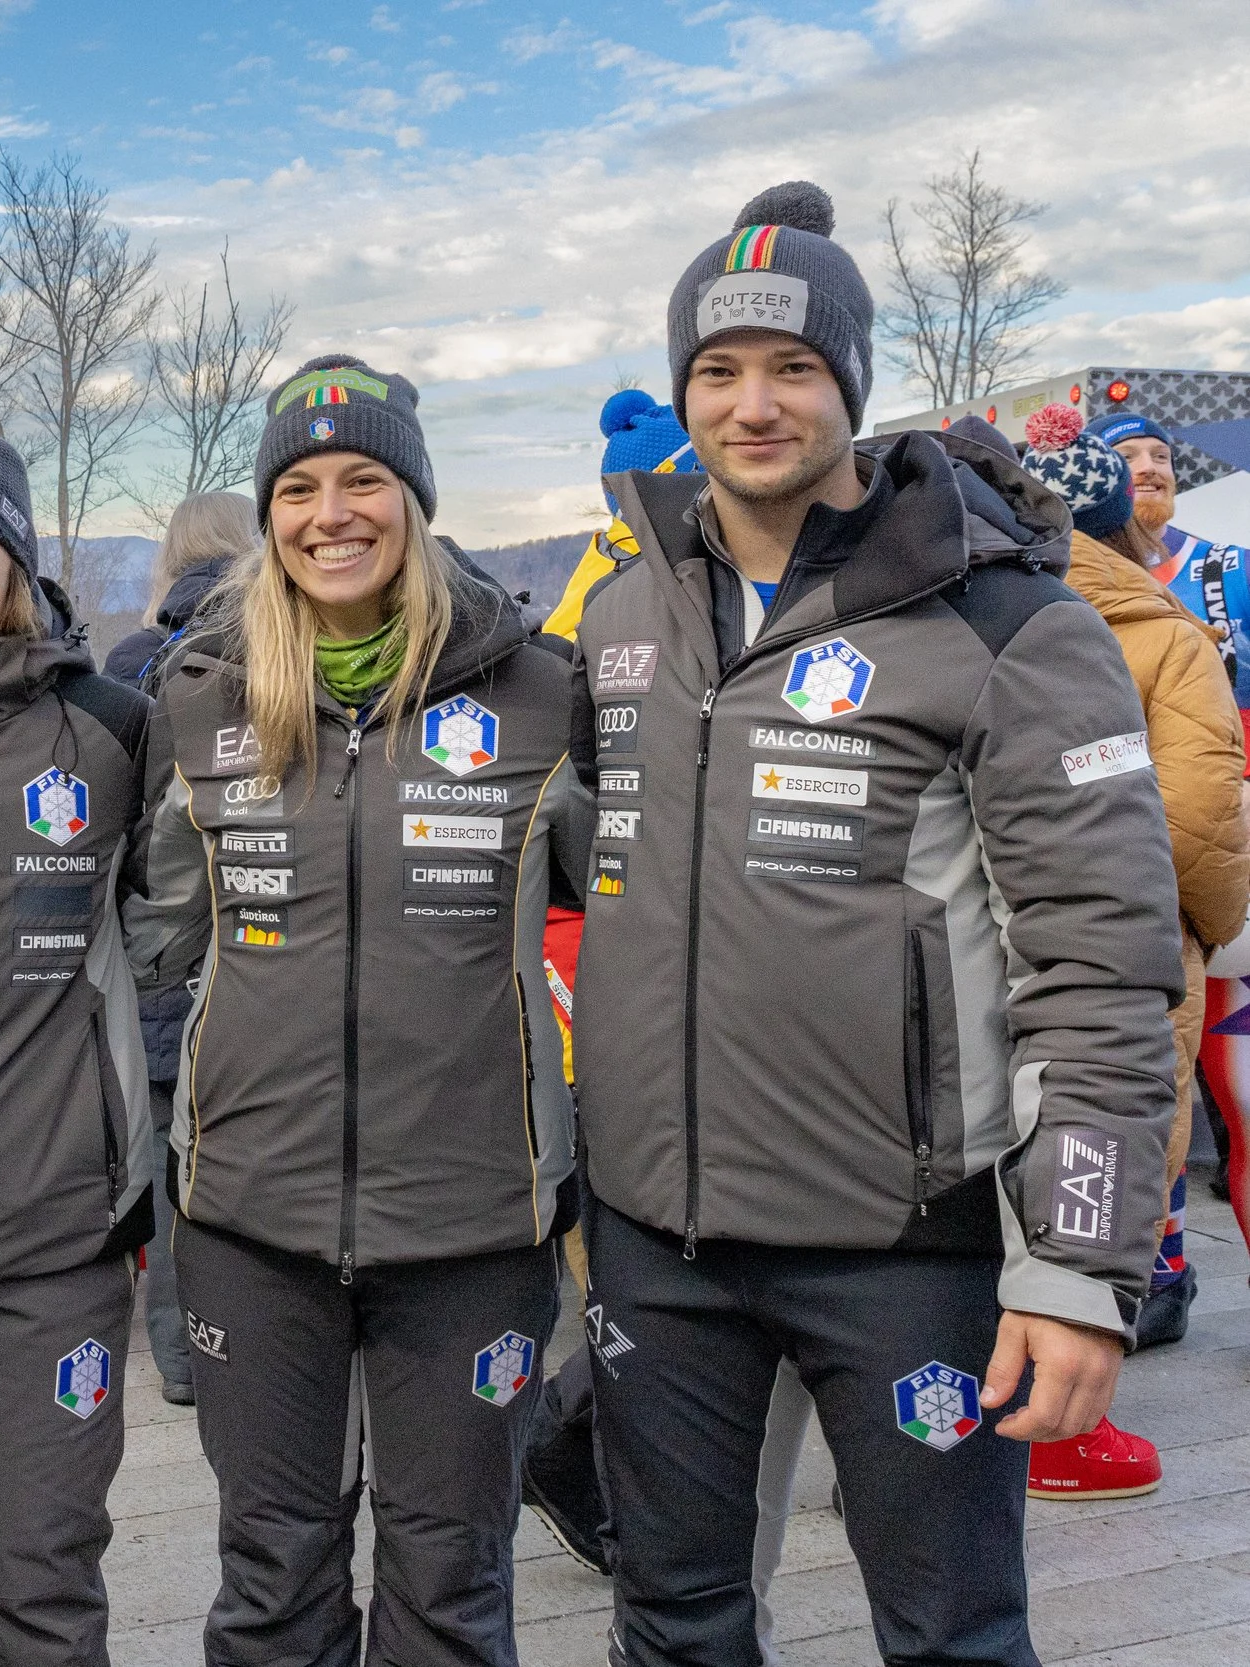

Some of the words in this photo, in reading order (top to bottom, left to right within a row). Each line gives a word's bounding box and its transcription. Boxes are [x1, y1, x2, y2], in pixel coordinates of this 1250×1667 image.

[711, 292, 792, 310] PUTZER
[1204, 581, 1236, 660] uvex
[598, 645, 655, 679] EA7
[811, 645, 860, 669] FISI
[439, 702, 485, 721] FISI
[217, 723, 262, 758] EA
[754, 728, 871, 756] FALCONERI
[1063, 752, 1092, 773] Der
[36, 773, 77, 792] FISI
[600, 771, 640, 791] RELLI
[786, 778, 861, 795] ESERCITO
[405, 783, 508, 803] FALCONERI
[224, 806, 248, 817] Audi
[434, 827, 497, 840] ESERCITO
[598, 809, 641, 838] ORST
[772, 819, 853, 841] FINSTRAL
[222, 831, 288, 853] PIRELLI
[16, 856, 96, 872] FALCONERI
[746, 860, 858, 876] PIQUADRO
[220, 865, 294, 895] FORST
[427, 868, 495, 883] FINSTRAL
[404, 907, 498, 917] PIQUADRO
[33, 934, 87, 949] FINSTRAL
[1103, 1140, 1118, 1182] ARMANI
[1057, 1134, 1104, 1239] EA7
[1099, 1193, 1114, 1241] EMPORIO
[187, 1310, 225, 1351] EA7
[585, 1303, 637, 1359] A7
[71, 1345, 104, 1366] FISI
[490, 1338, 527, 1359] FISI
[910, 1369, 963, 1390] FISI
